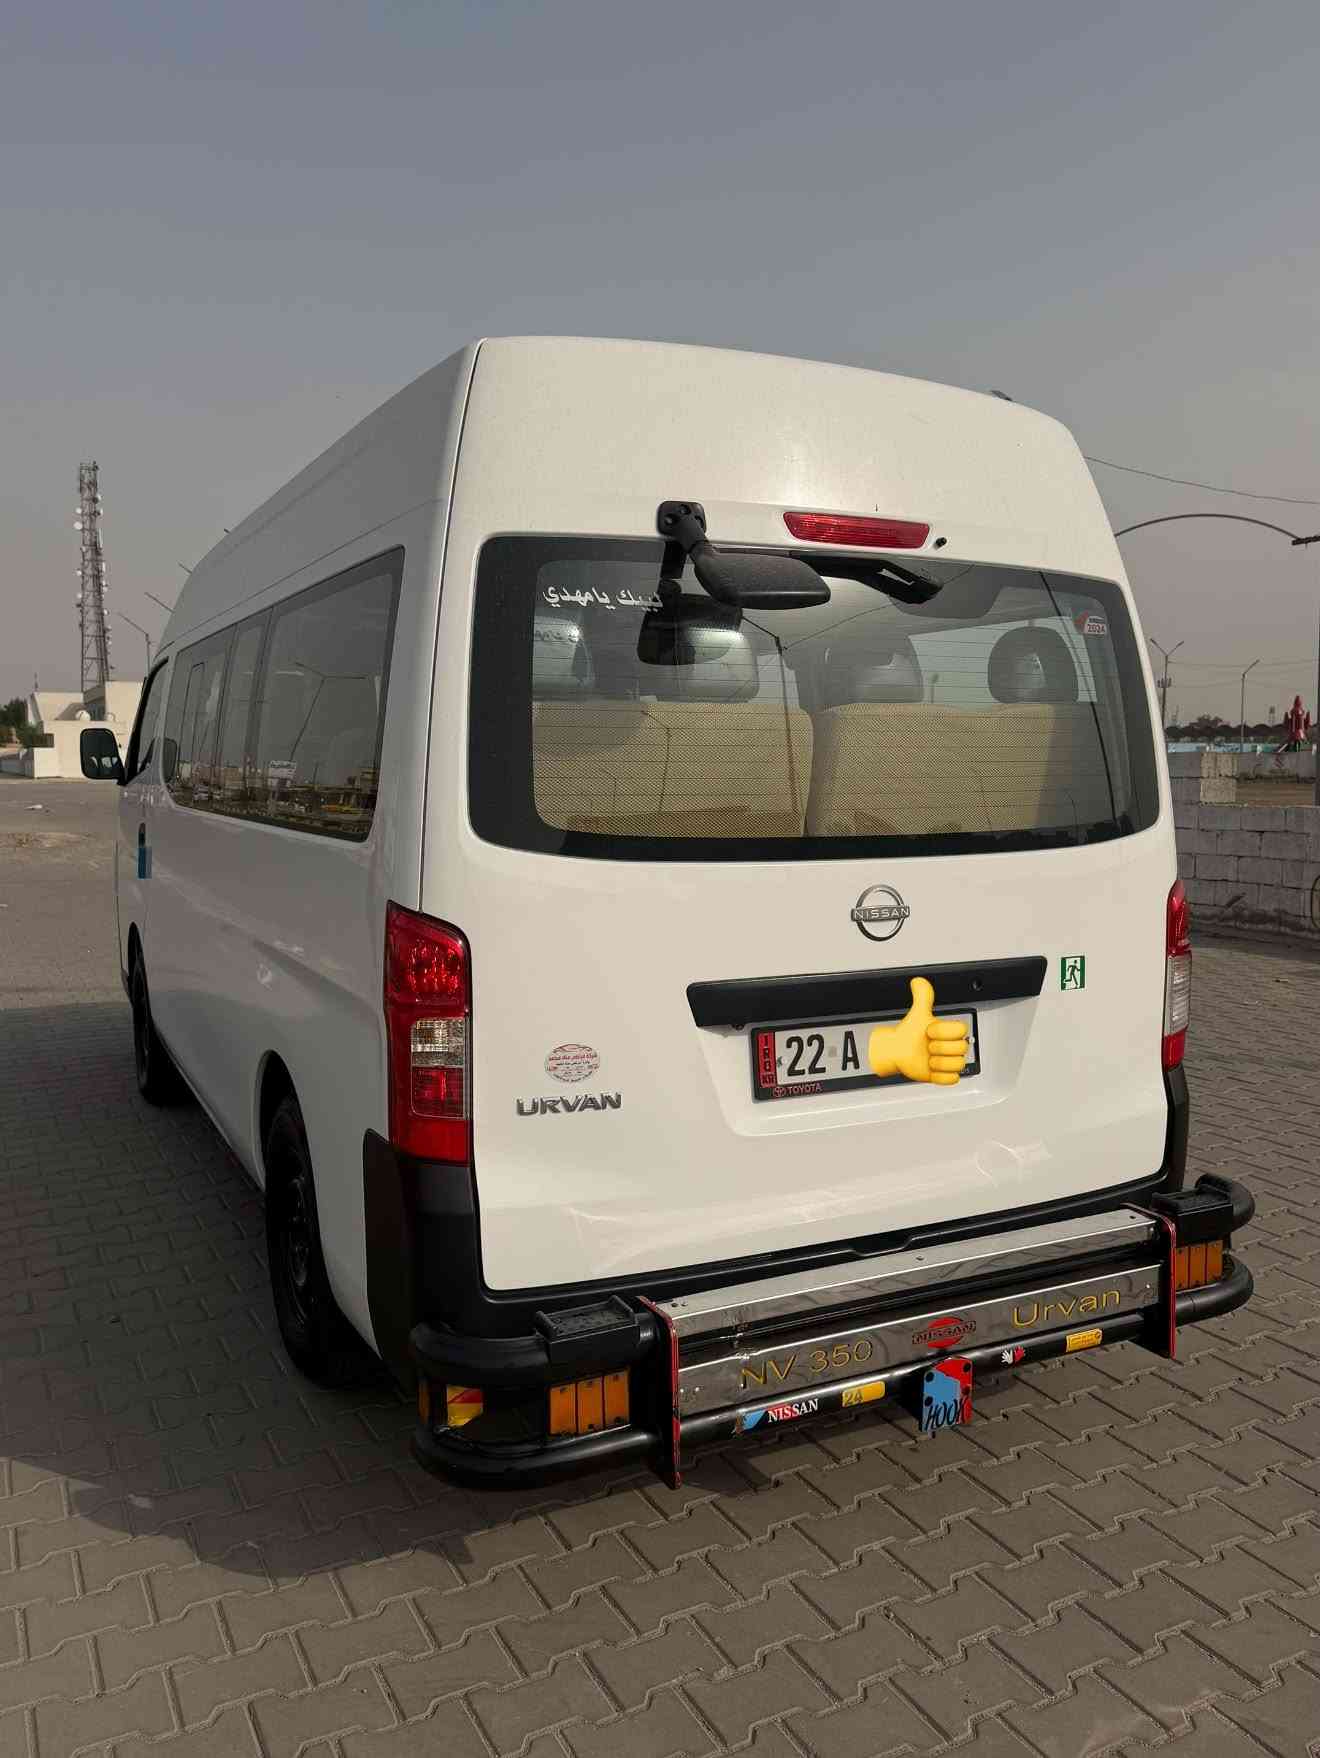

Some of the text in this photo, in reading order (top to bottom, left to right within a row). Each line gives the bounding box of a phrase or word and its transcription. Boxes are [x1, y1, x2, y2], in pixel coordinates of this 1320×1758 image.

[852, 906, 910, 921] NISSAN
[786, 1031, 860, 1077] 22 A
[788, 1082, 823, 1095] TOYOTA
[516, 1092, 622, 1116] URVAN
[1012, 1290, 1120, 1328] Urvan
[912, 1320, 976, 1345] NISSAN
[739, 1339, 873, 1389] NV 350
[768, 1398, 819, 1423] NISSAN
